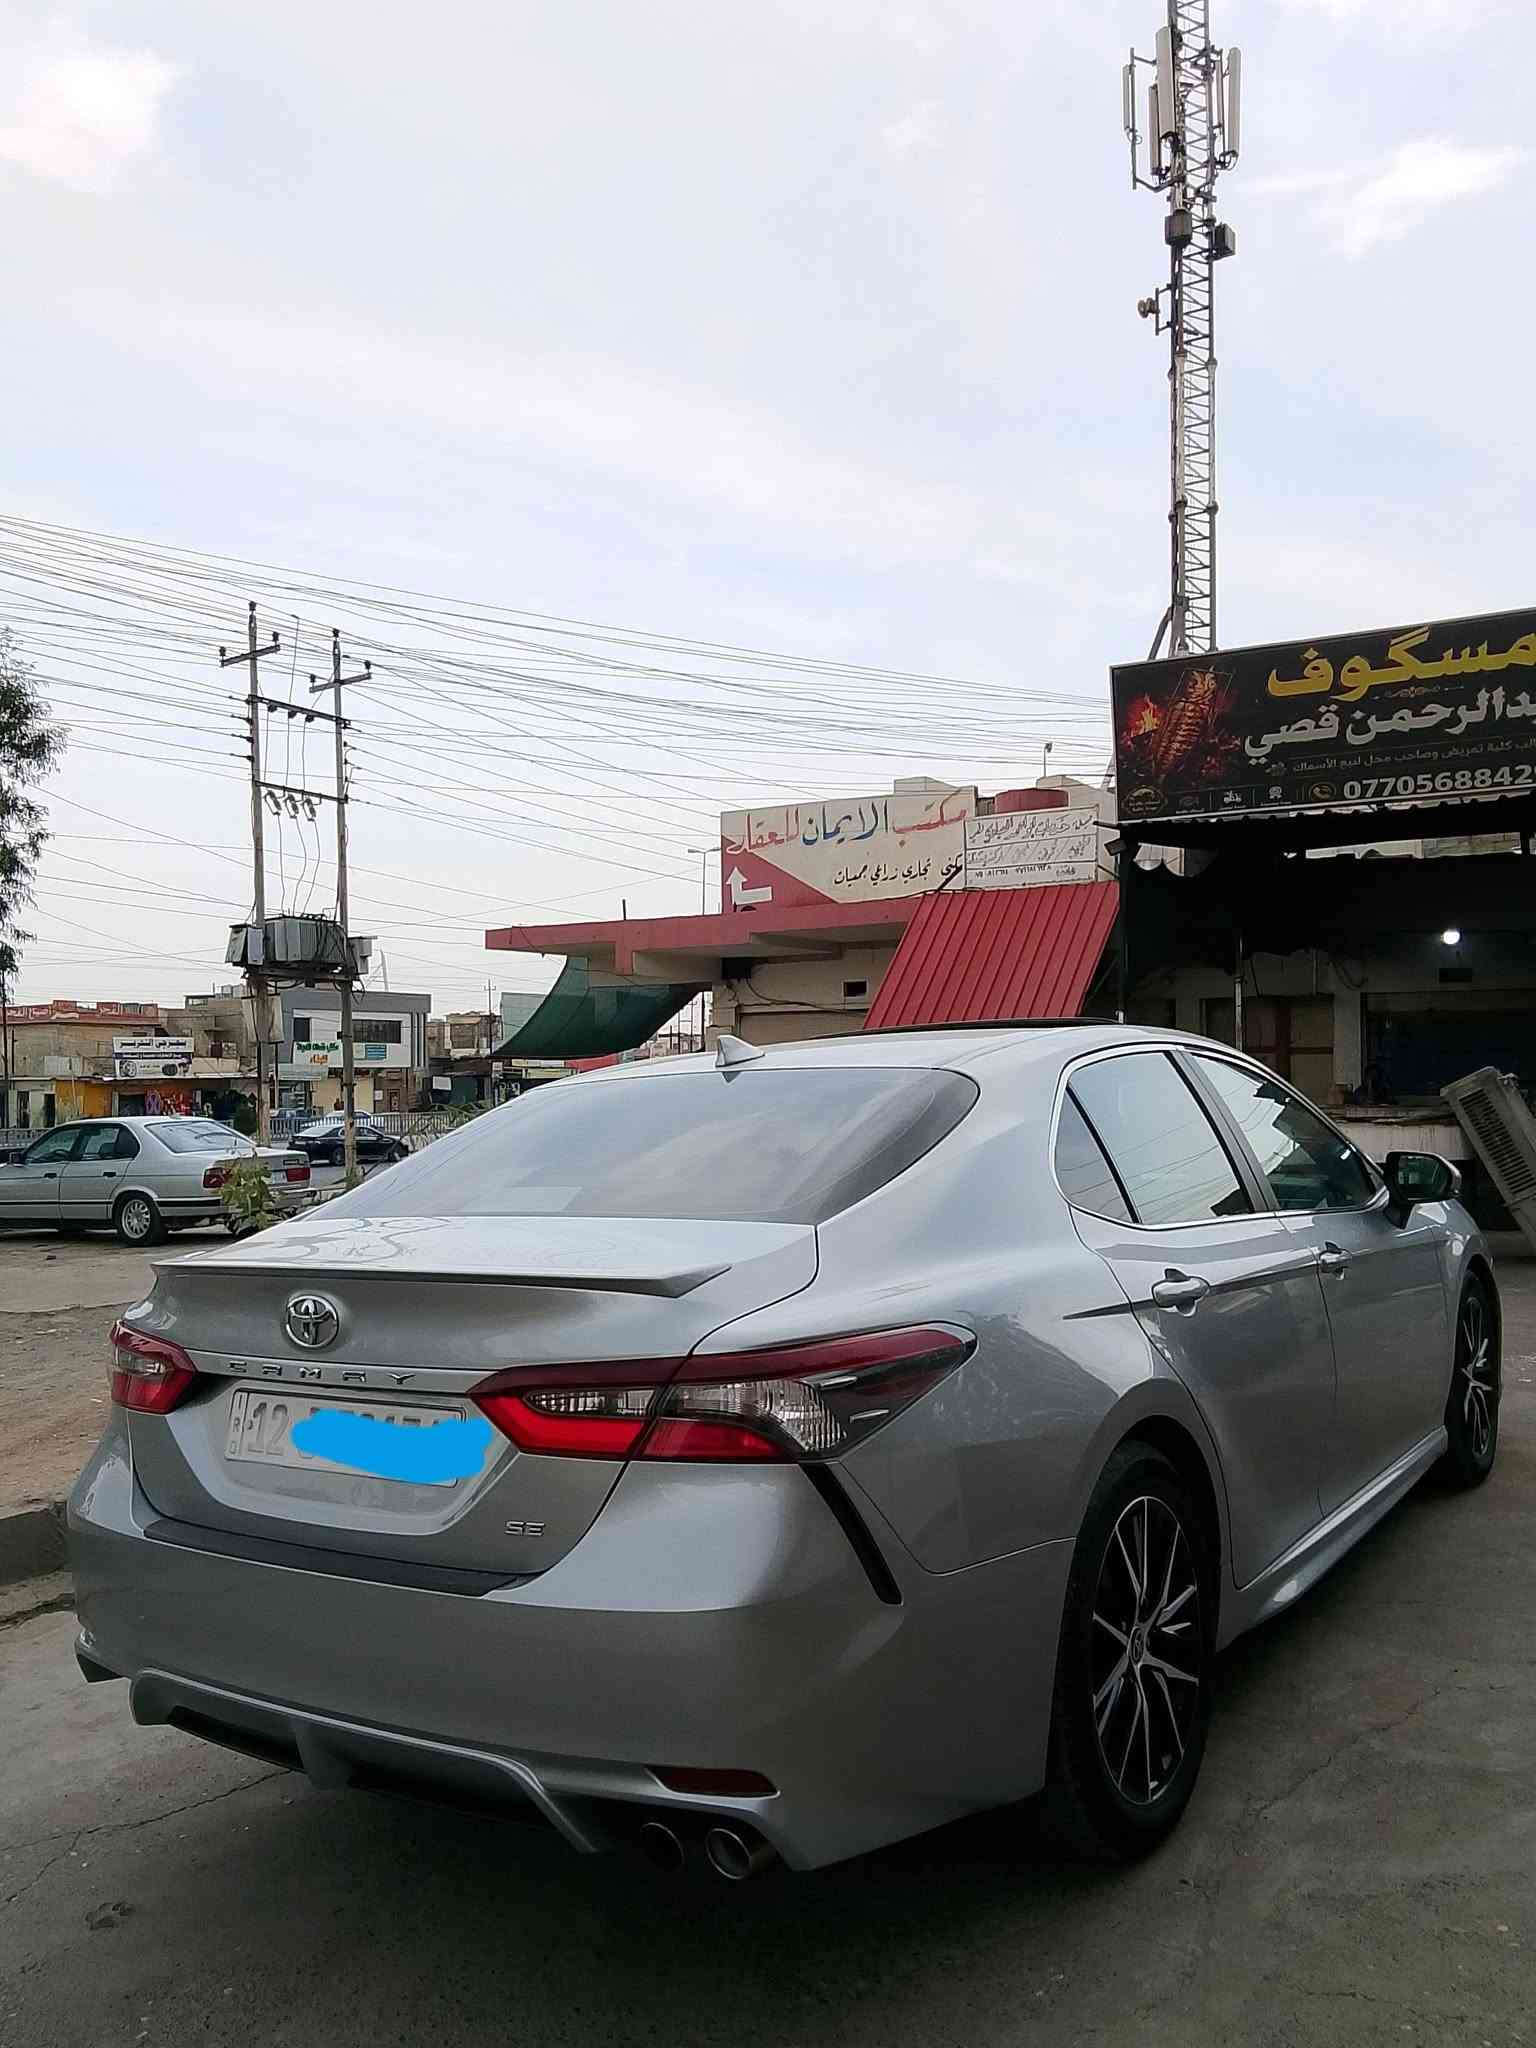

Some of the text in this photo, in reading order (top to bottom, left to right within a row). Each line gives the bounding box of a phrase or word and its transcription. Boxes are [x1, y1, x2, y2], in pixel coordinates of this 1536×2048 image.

[1244, 704, 1340, 767] قصي
[1339, 755, 1361, 770] لبيع
[1363, 754, 1392, 767] محل
[1343, 764, 1536, 800] 0770568842
[892, 787, 968, 847] مكتب
[870, 863, 898, 886] زراعي
[902, 857, 932, 883] تجاري
[229, 1360, 417, 1386] CAMRY
[504, 1520, 545, 1537] SE
